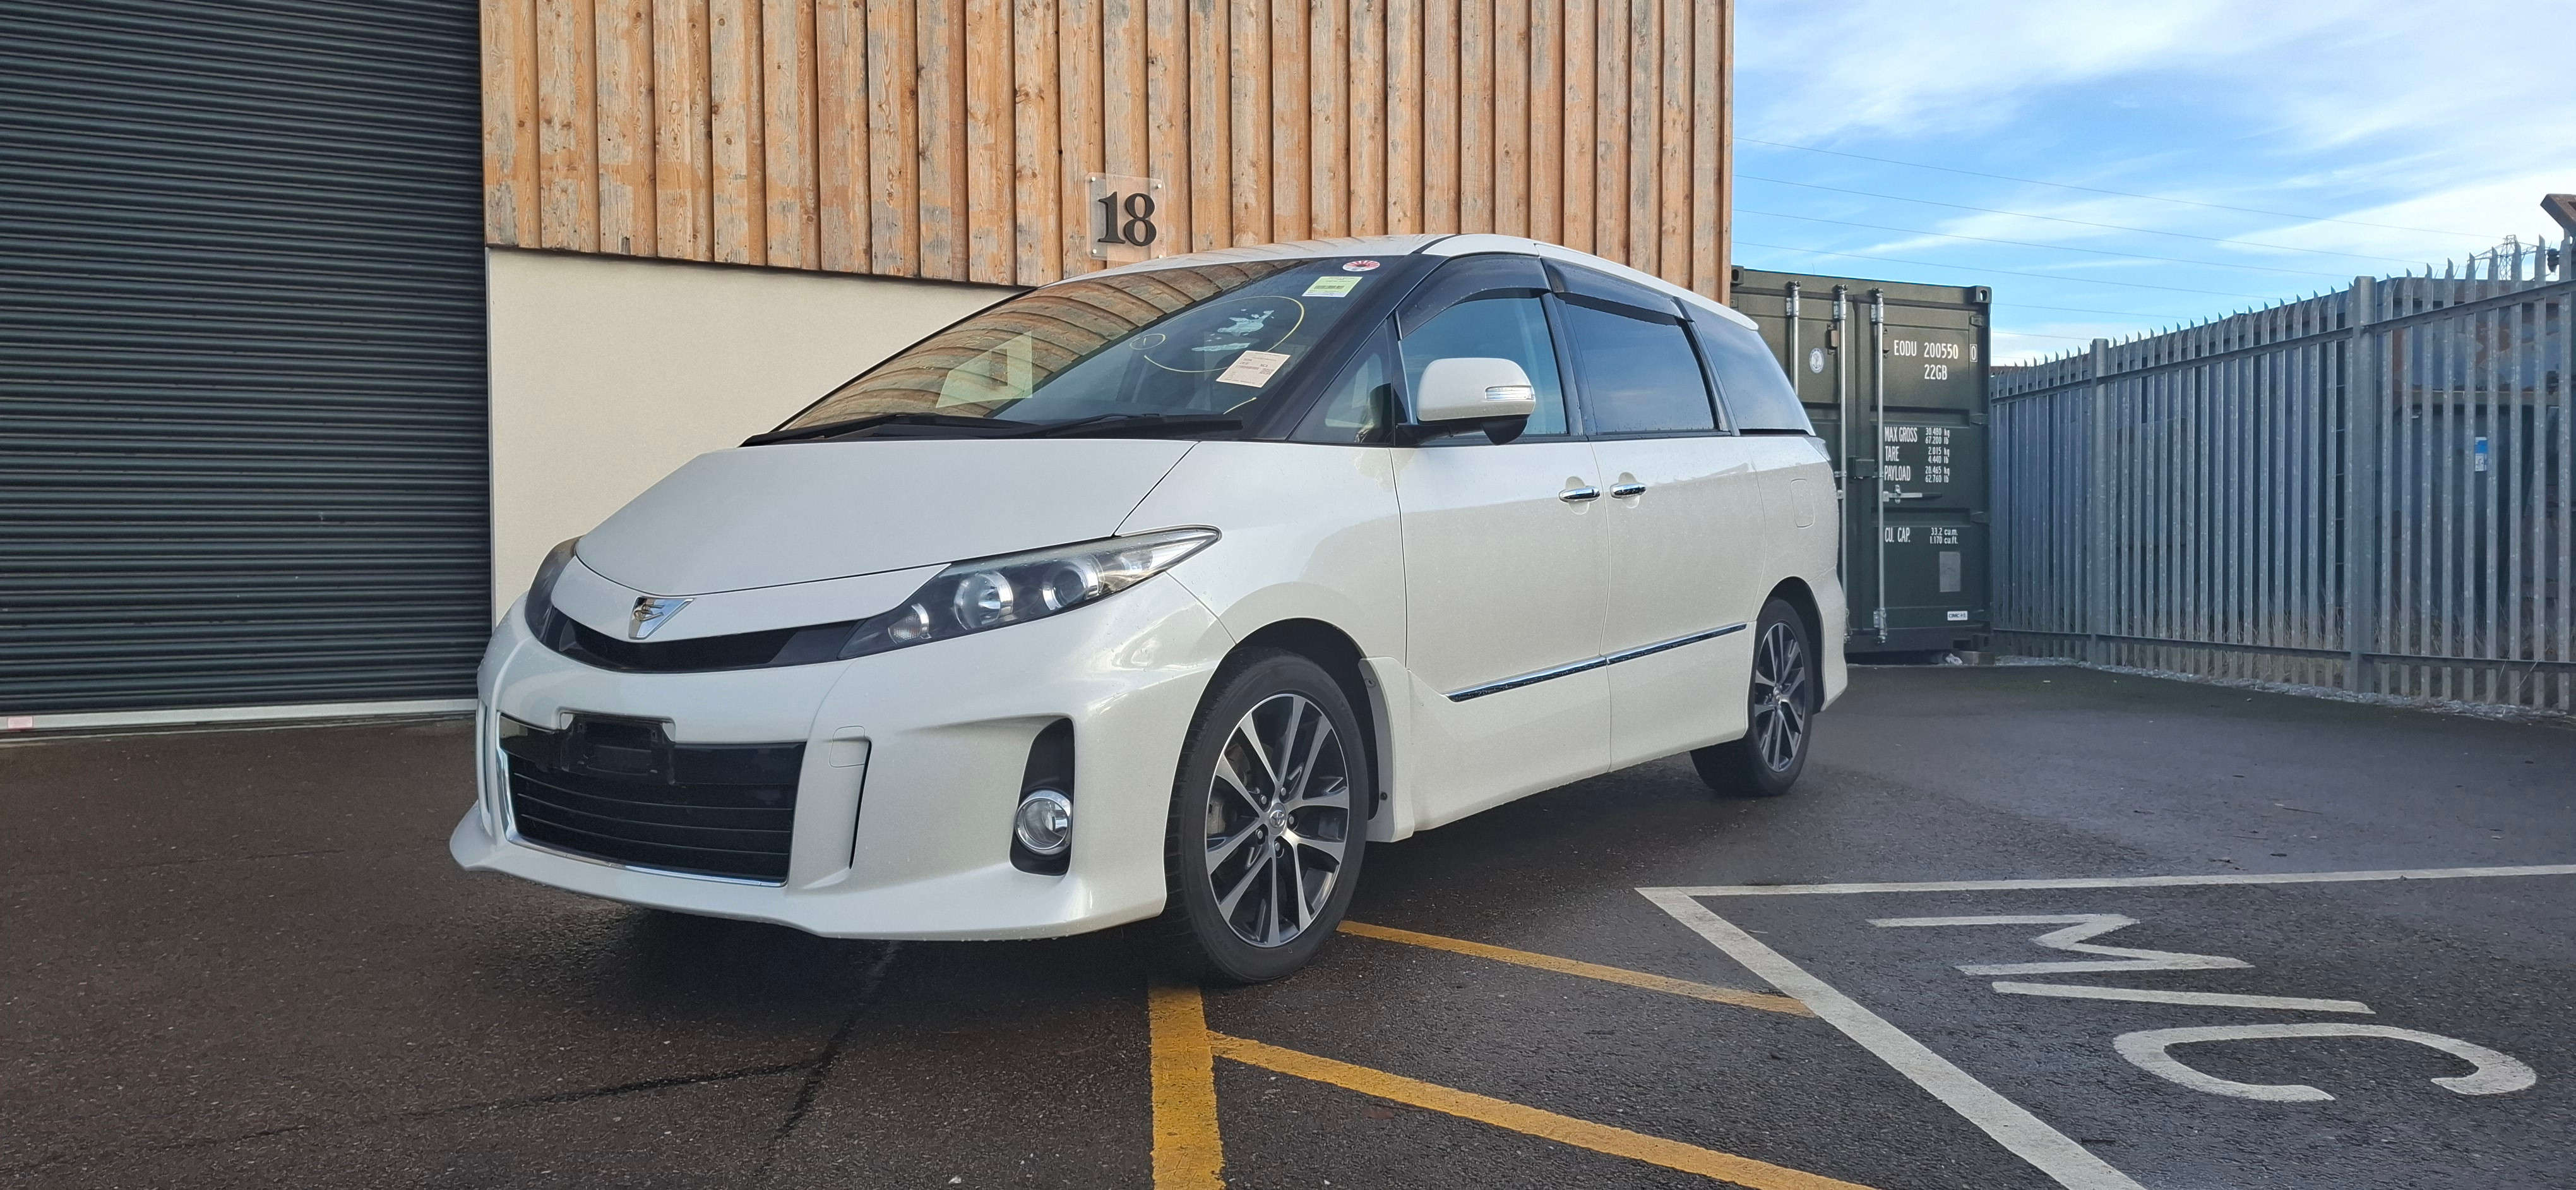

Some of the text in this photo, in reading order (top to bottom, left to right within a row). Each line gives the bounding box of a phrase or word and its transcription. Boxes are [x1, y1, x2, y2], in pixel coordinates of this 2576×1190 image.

[1097, 191, 1157, 246] 18
[1894, 340, 1977, 361] EODU 200550 0
[1924, 364, 1948, 380] 22GB
[1884, 426, 1917, 443] MAX GROSS
[1943, 428, 1950, 438] kg
[1925, 436, 1949, 445] 67.200 lb
[1885, 446, 1900, 462] TARE
[1928, 447, 1950, 457] 2.015 kg
[1928, 455, 1949, 464] 4.440 lb
[1884, 465, 1911, 481] PAYLOAD
[1925, 466, 1950, 476] 28.465 kg
[1925, 474, 1949, 483] 62.760 lb
[1885, 527, 1911, 543] CU. CAP.
[1931, 527, 1943, 536] 33.2
